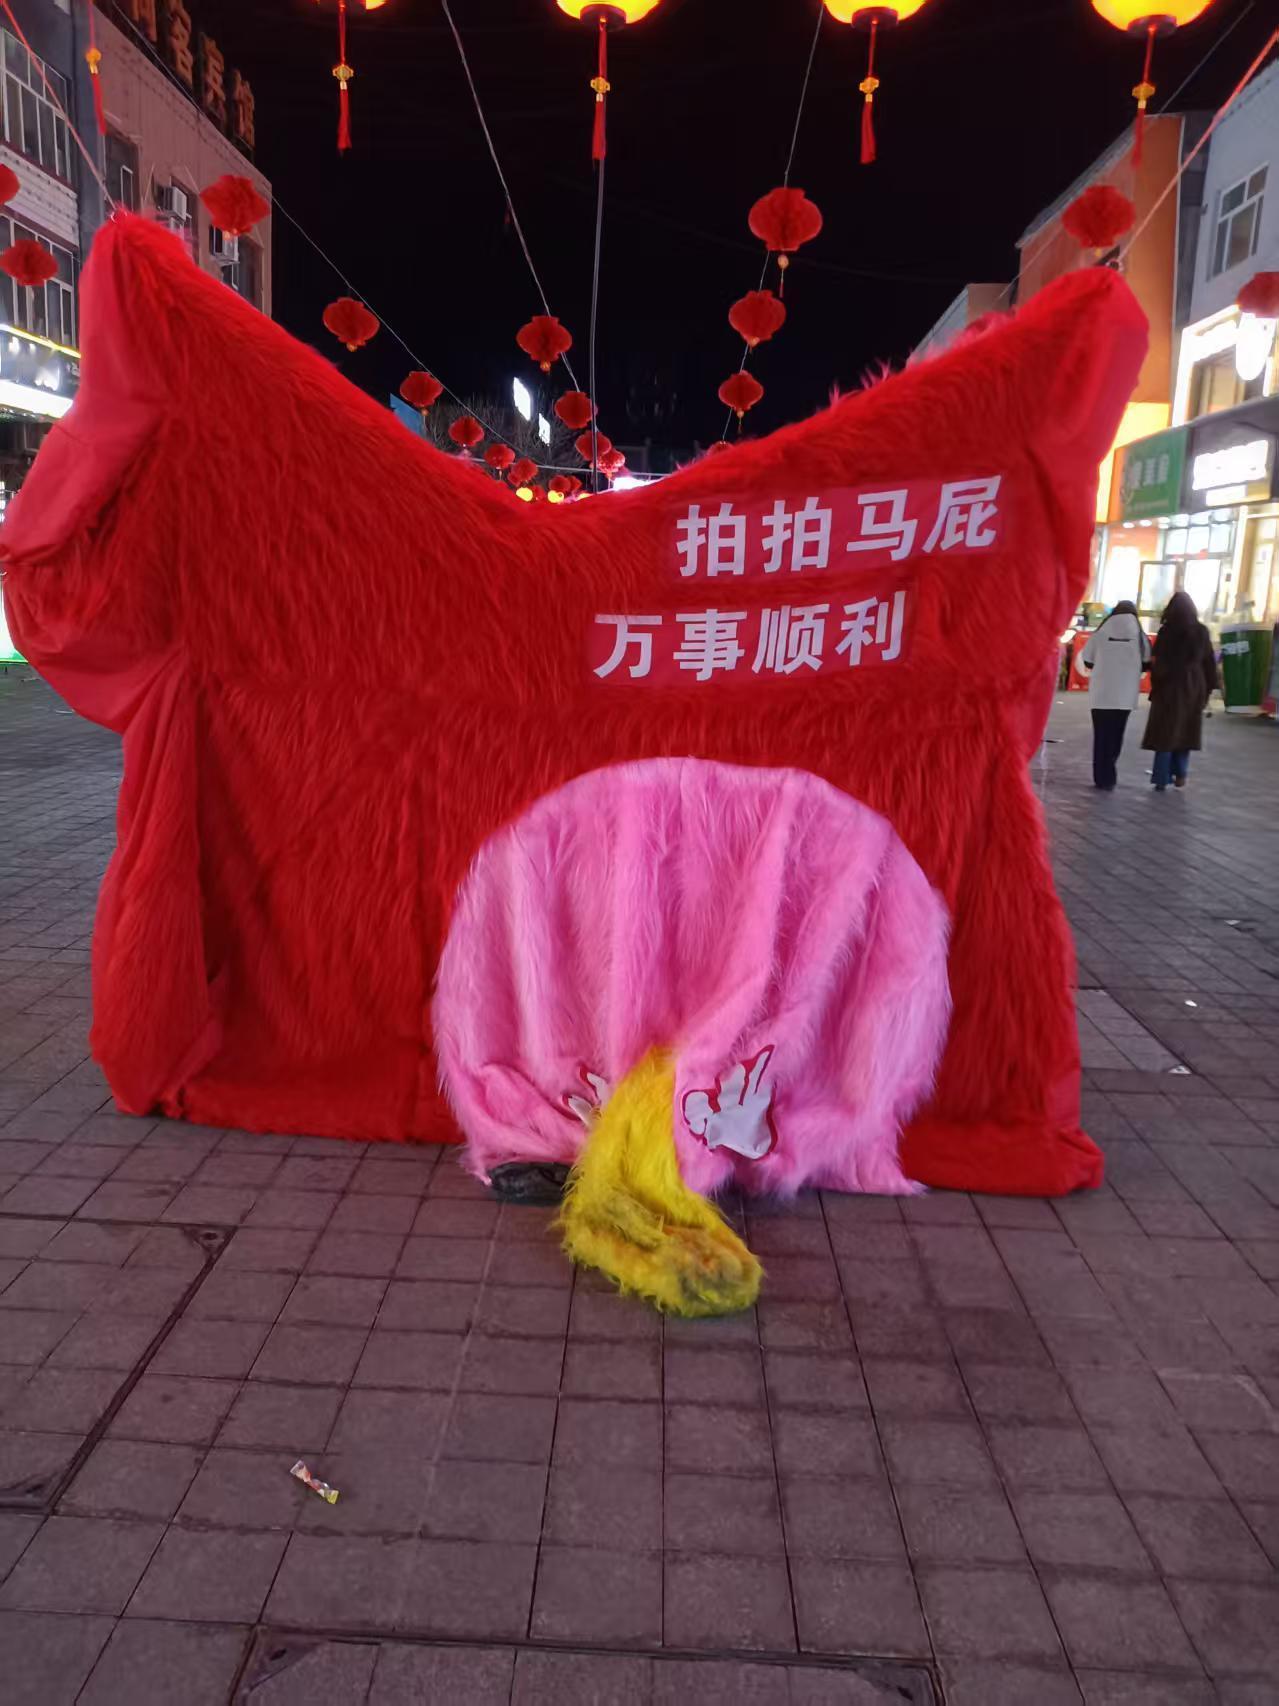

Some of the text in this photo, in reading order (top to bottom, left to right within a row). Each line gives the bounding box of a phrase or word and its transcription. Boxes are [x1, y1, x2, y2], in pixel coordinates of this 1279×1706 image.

[676, 475, 1001, 577] 拍拍马屁
[593, 591, 906, 681] 万事顺利
